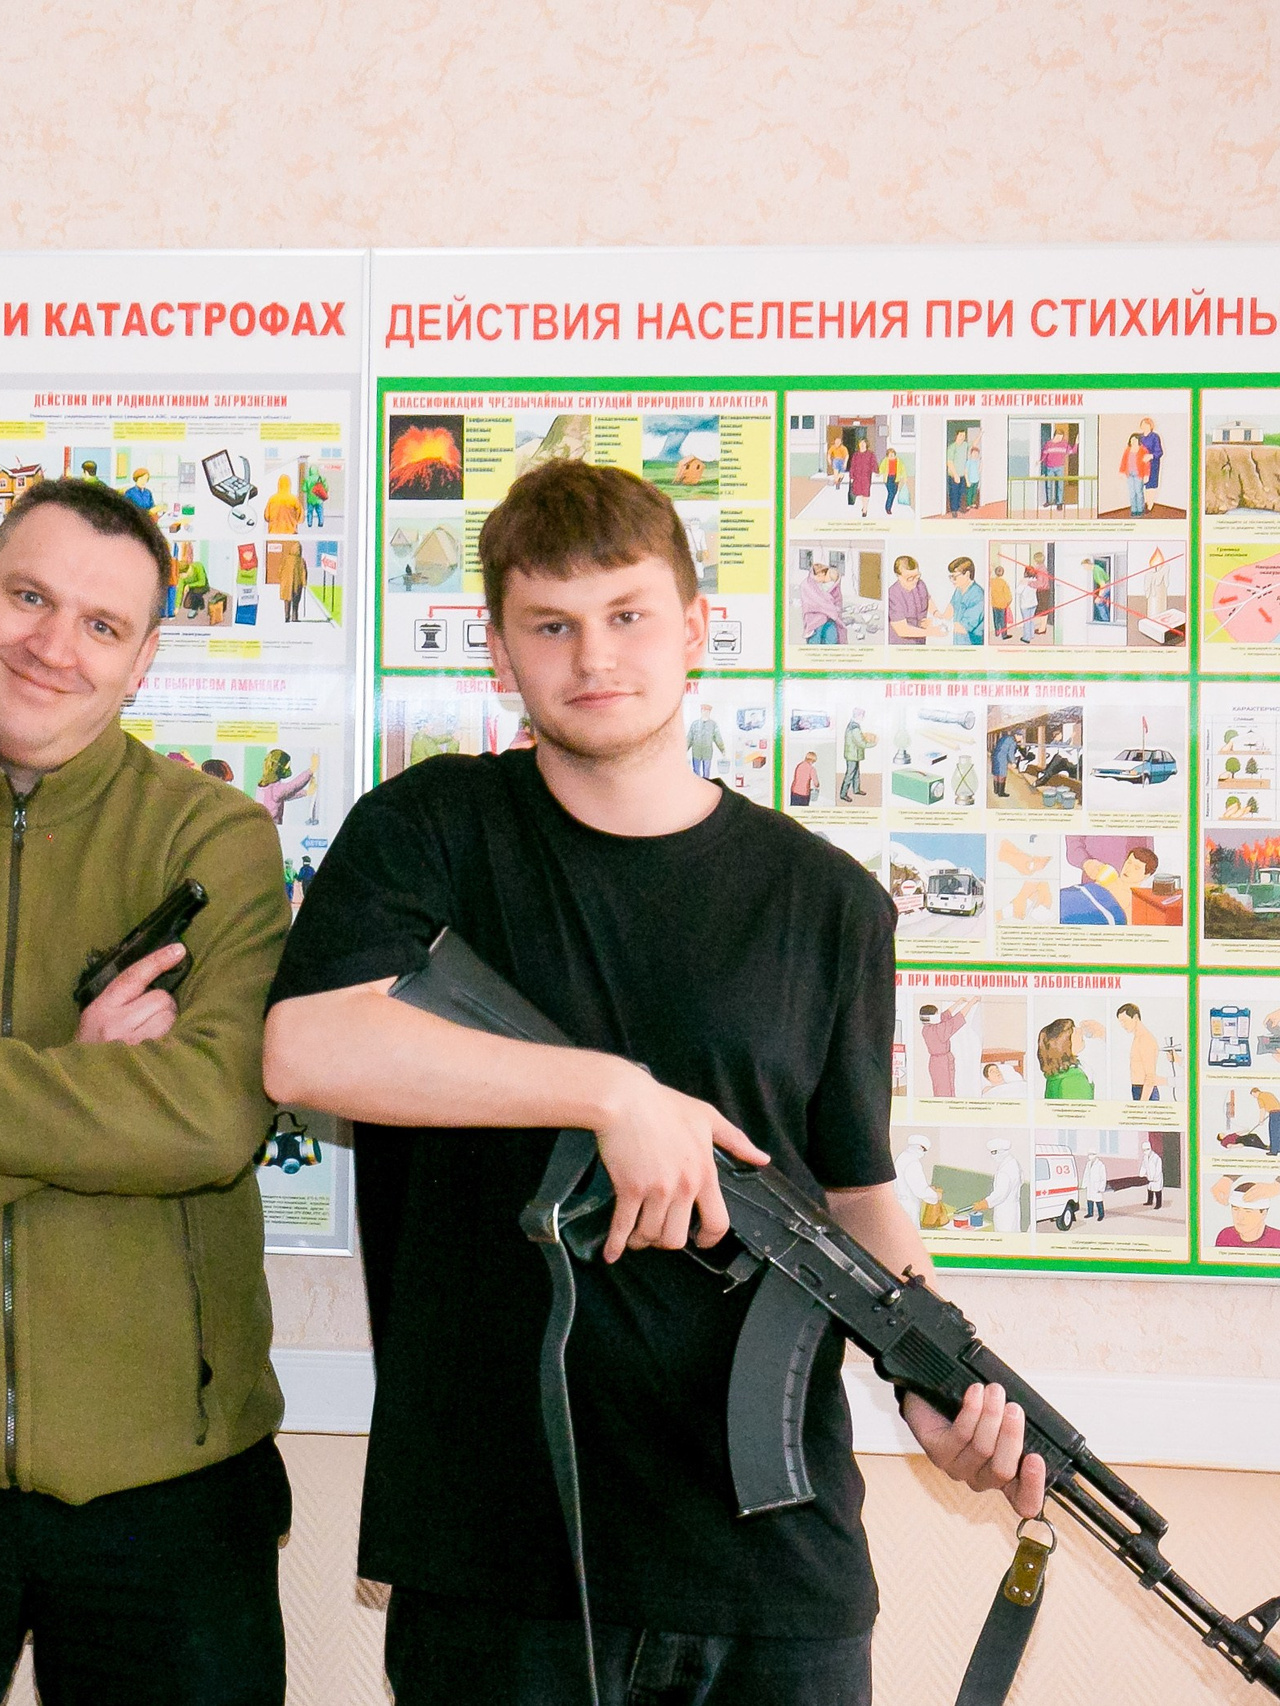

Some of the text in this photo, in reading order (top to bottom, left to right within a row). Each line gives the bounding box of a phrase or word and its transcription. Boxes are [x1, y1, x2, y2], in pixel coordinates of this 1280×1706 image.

[4, 301, 29, 338] И
[45, 301, 346, 339] КАТАСТРОФАХ
[385, 294, 621, 349] ДЕЙСТВИЯ
[637, 299, 909, 340] НАСЕЛЕНИЯ
[926, 299, 1014, 339] ПРИ
[34, 392, 288, 408] ДЕЙСТВИЯ ПРИ РАДИОАКТИВНОМ ЗАГРЯЗНЕНИИ
[392, 395, 769, 409] КЛАССИФИКАЦИЯ ЧРЕЗВЫЧАЙНЫХ СИТУАЦИЙ ПРИРОДНОГО ХАРАКТЕРА
[892, 391, 1084, 409] ДЕЙСТВИЯ ПРИ ЗЕМЛЕТРЯСЕНИЯХ
[885, 682, 1086, 698] ДЕЙСТВИЯ ПРИ СНЕЖНЫХ ЗАНОСАХ
[907, 973, 930, 986] ПРИ
[935, 973, 1028, 988] ИНФЕКЦИОННЫХ
[1033, 975, 1121, 989] ЗАБОЛЕВАНИЯХ
[1055, 1165, 1071, 1175] 03
